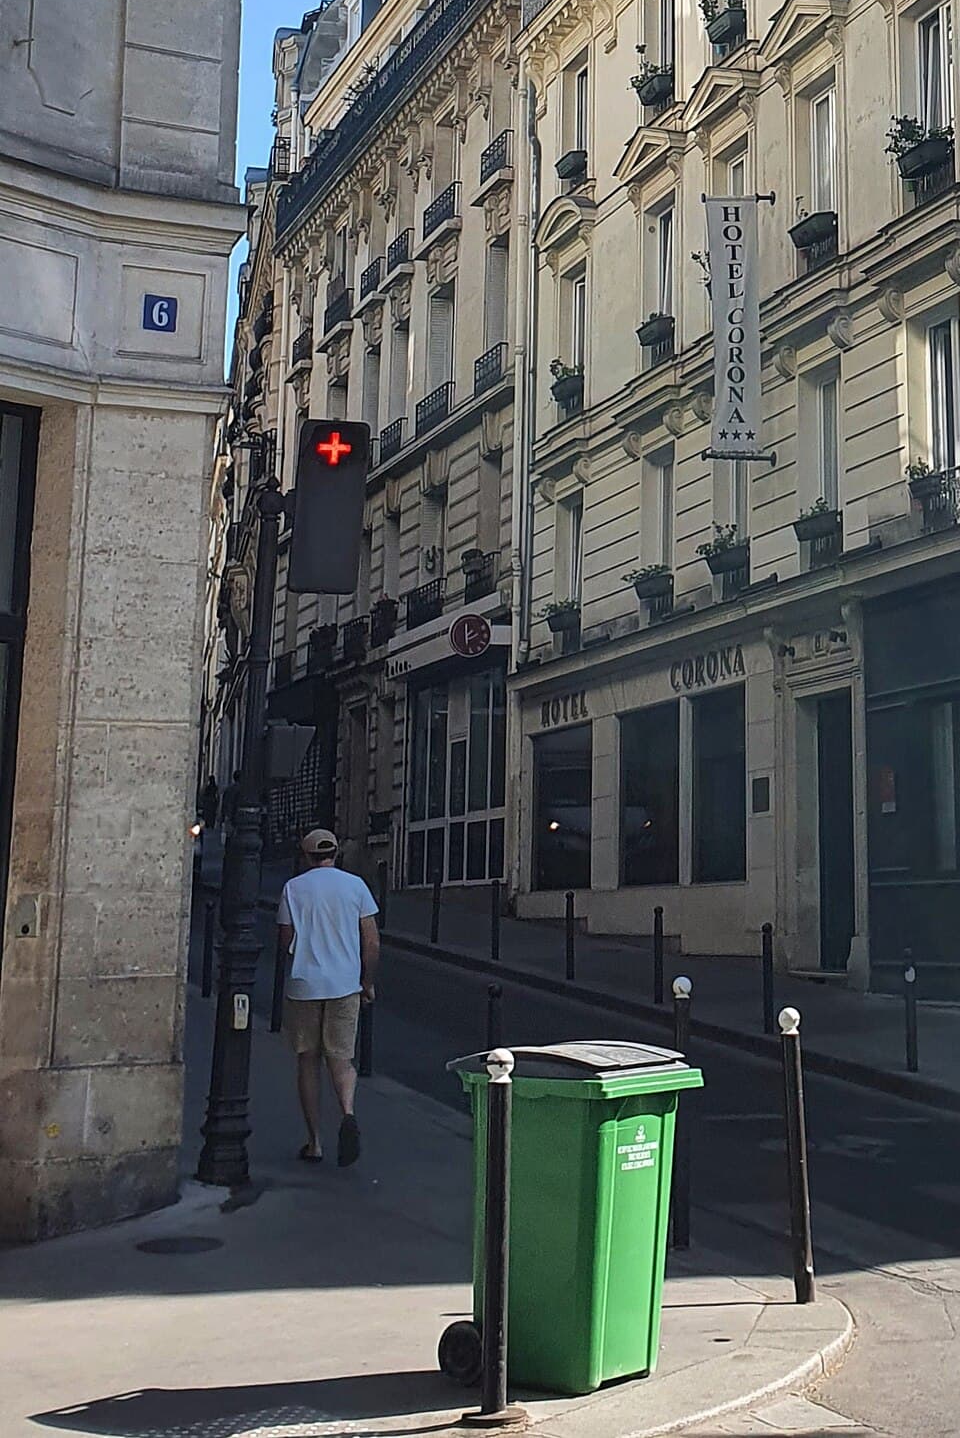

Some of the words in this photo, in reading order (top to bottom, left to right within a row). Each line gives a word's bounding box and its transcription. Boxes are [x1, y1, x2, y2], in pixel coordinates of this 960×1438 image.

[721, 206, 745, 299] HOTEL
[152, 300, 169, 327] 6
[727, 307, 746, 424] CORONA
[541, 689, 588, 727] HOTEL
[669, 643, 747, 693] CORONA
